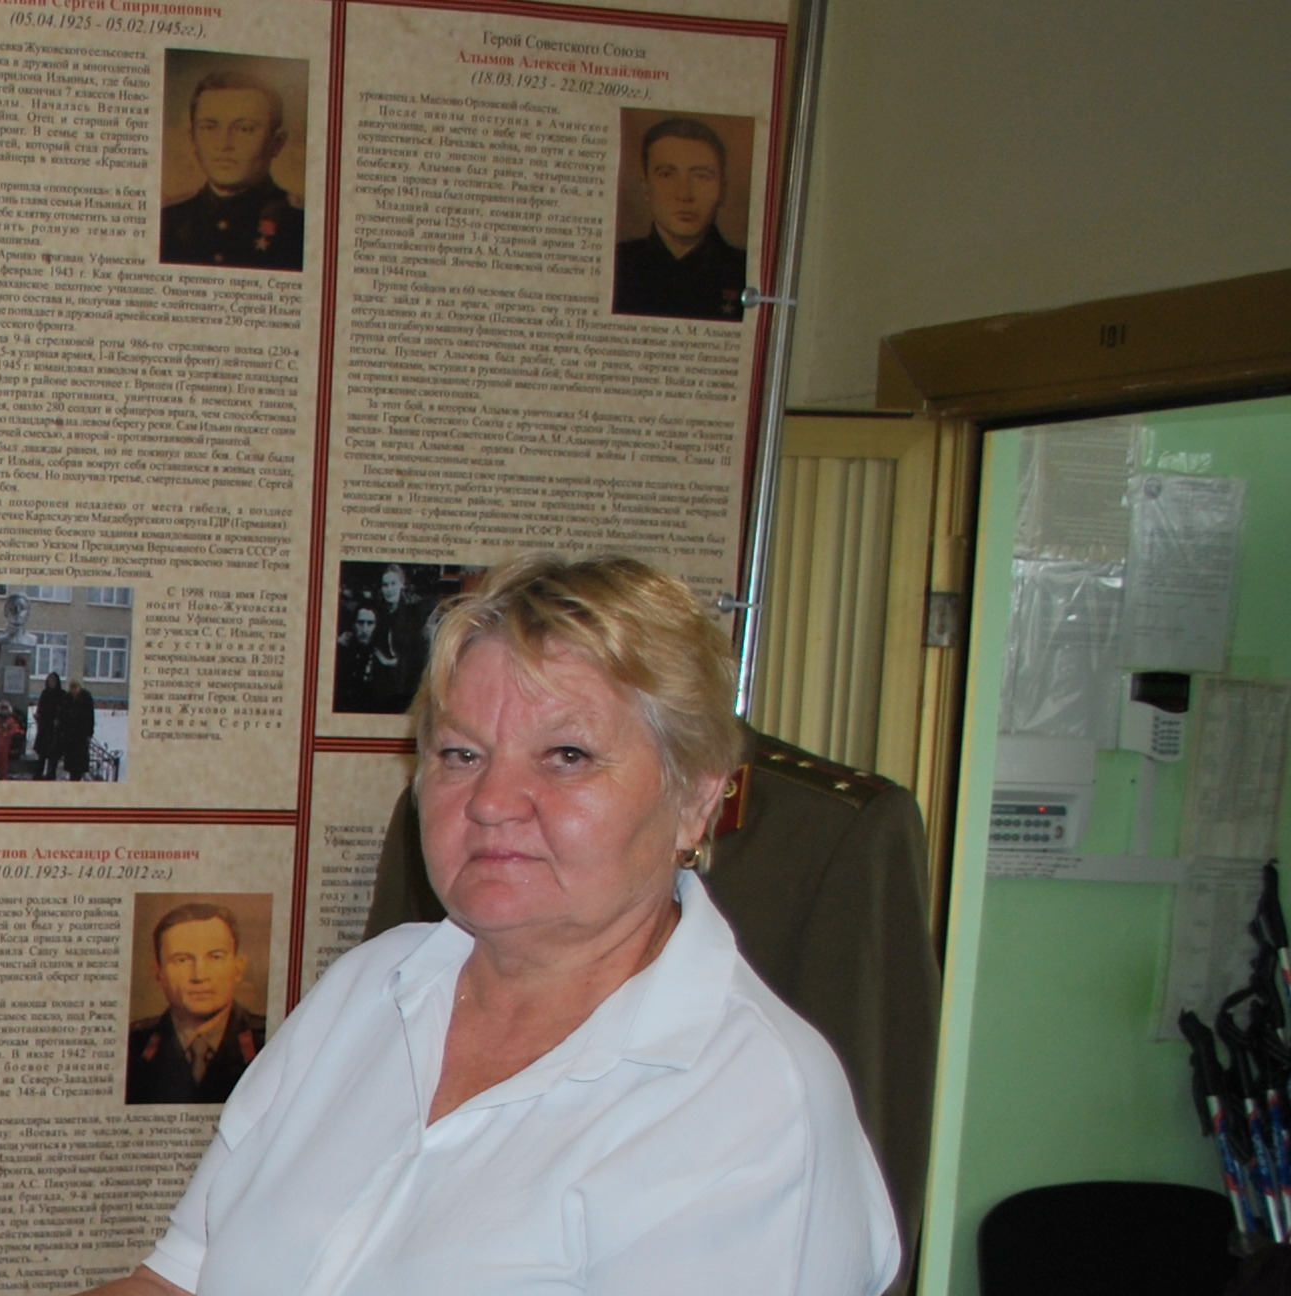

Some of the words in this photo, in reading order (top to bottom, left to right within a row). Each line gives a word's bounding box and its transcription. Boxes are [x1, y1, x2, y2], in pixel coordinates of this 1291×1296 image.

[109, 0, 222, 18] Спиридонович
[10, 11, 91, 30] (05.04.1925
[106, 17, 206, 37] 05.02.1945гг.),
[483, 30, 522, 51] Герой
[526, 35, 599, 55] Советского
[603, 42, 646, 59] Союза
[457, 50, 514, 67] Алымов
[519, 56, 576, 72] Алексей
[581, 61, 669, 81] Михайлович
[167, 586, 176, 598] С
[32, 849, 111, 862] Александр
[115, 847, 199, 859] Степанович
[78, 865, 148, 878] 14.01.2012
